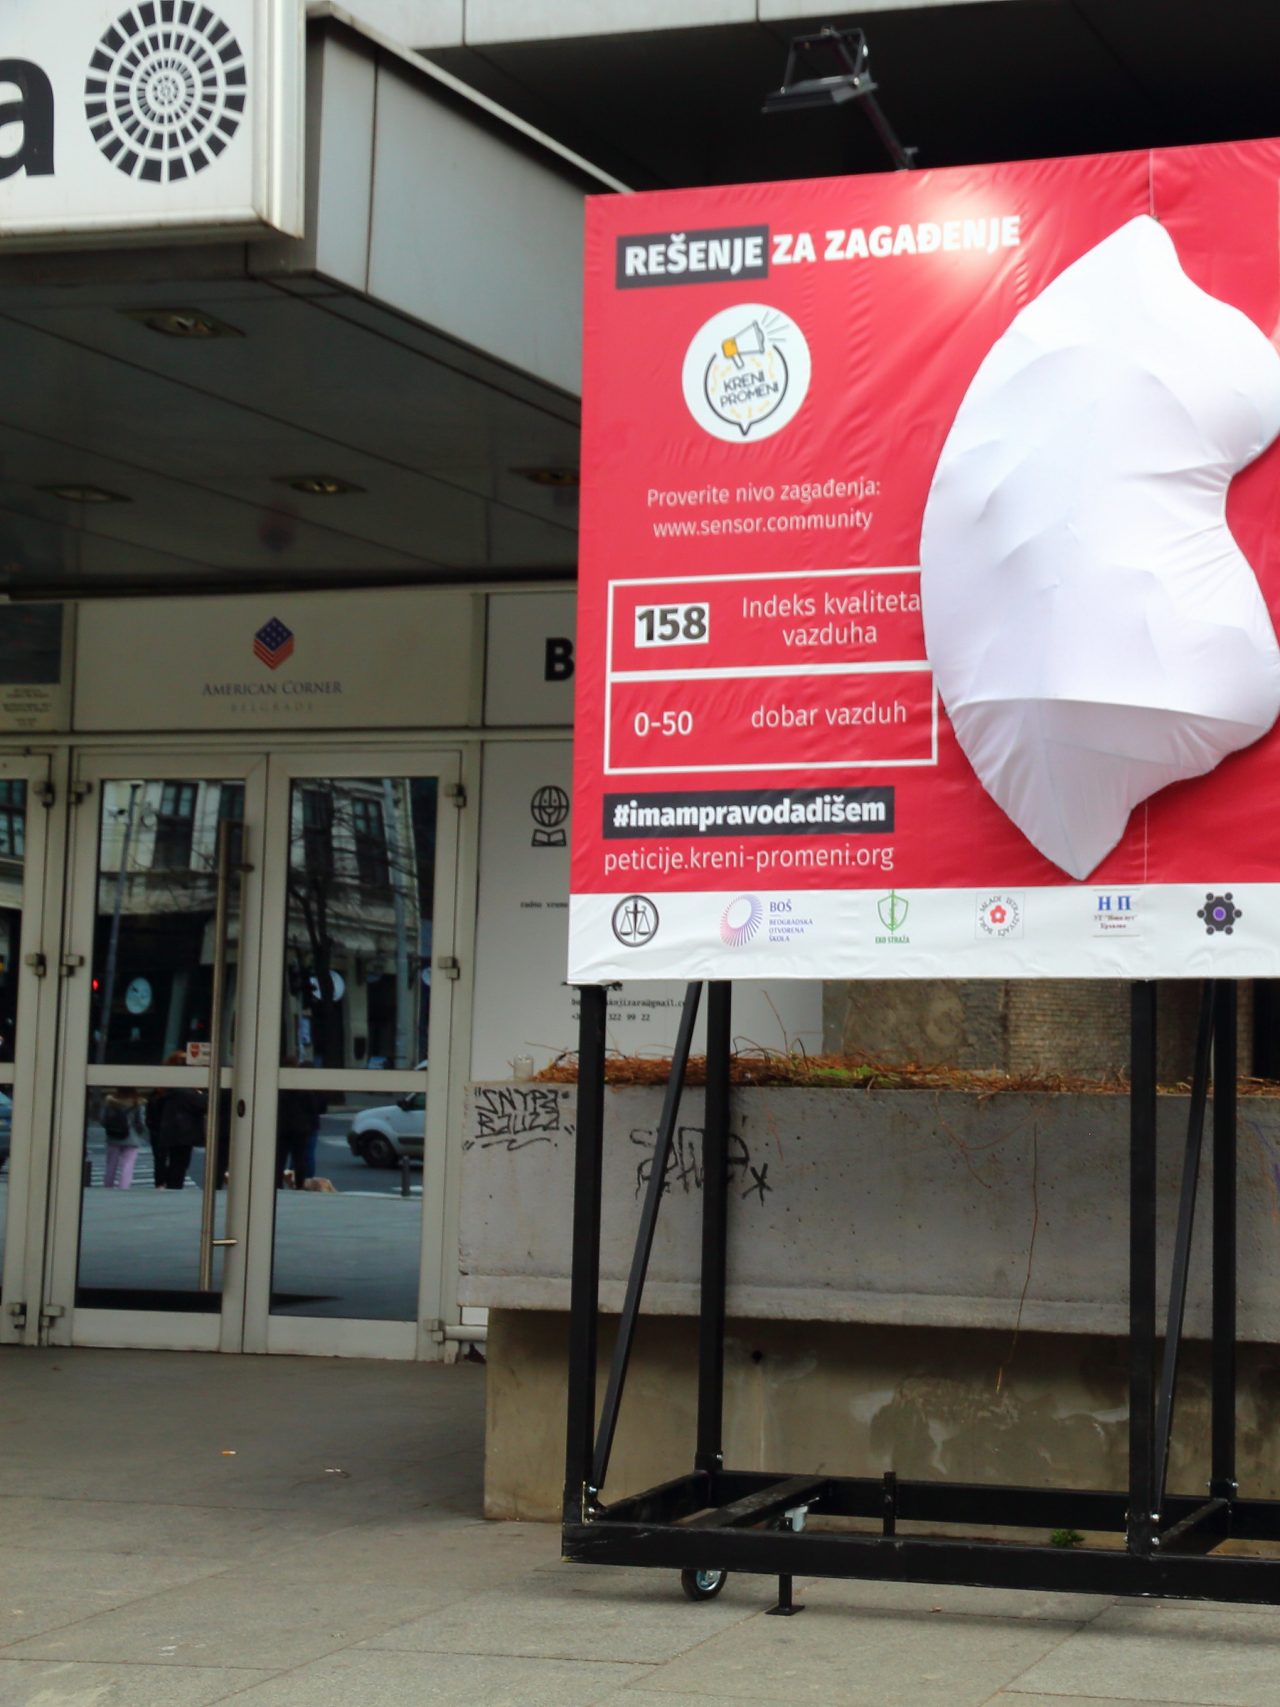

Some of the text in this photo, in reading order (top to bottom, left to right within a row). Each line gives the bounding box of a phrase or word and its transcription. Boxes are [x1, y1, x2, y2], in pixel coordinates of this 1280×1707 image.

[624, 216, 1021, 277] REŠENJE ZA ZAGAĐENJE
[720, 381, 779, 408] PROMENI
[724, 370, 765, 392] KRENI
[647, 475, 881, 508] Proverite nivo zagađenja:
[653, 509, 873, 538] www.sensor.community
[743, 590, 921, 619] Indeks kvaliteta
[637, 606, 707, 642] 158
[782, 622, 877, 648] vazduha
[634, 711, 693, 737] 0-50
[751, 701, 907, 729] dobar vazduh
[613, 795, 886, 833] #imampravodadišem
[604, 843, 895, 876] peticije.kreni-promeni.org
[769, 898, 793, 913] BOŠ
[769, 918, 814, 926] BEOGRADSKA
